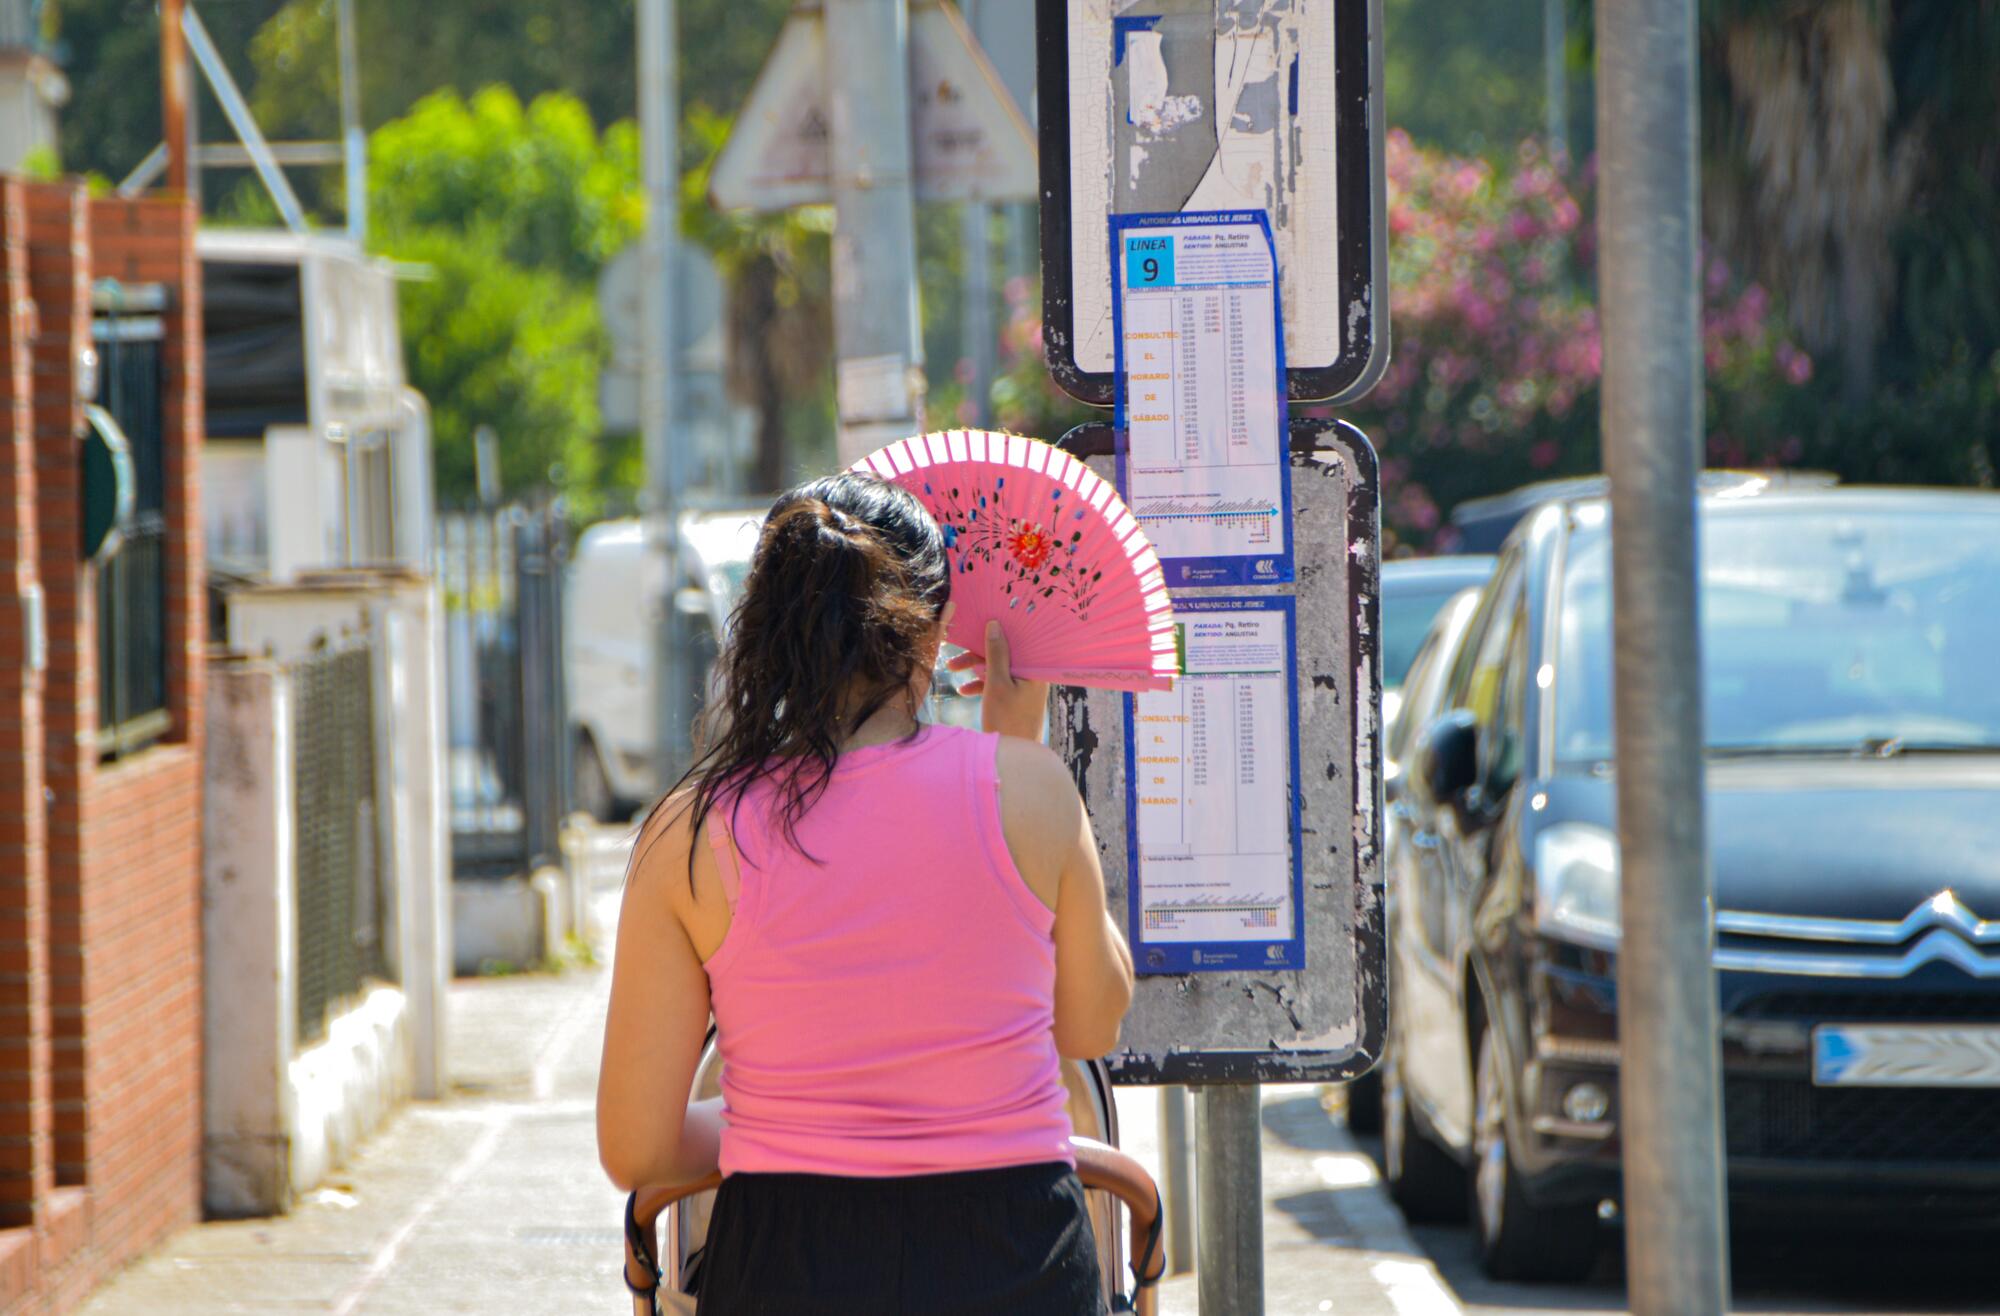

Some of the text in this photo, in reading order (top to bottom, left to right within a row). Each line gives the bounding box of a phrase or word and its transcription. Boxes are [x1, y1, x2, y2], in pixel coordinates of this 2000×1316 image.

[1182, 214, 1218, 224] URBANOS
[1231, 213, 1253, 222] JEREZ
[1142, 257, 1159, 282] 9
[1195, 601, 1229, 609] URBANOS
[1139, 756, 1179, 764] HORARIO
